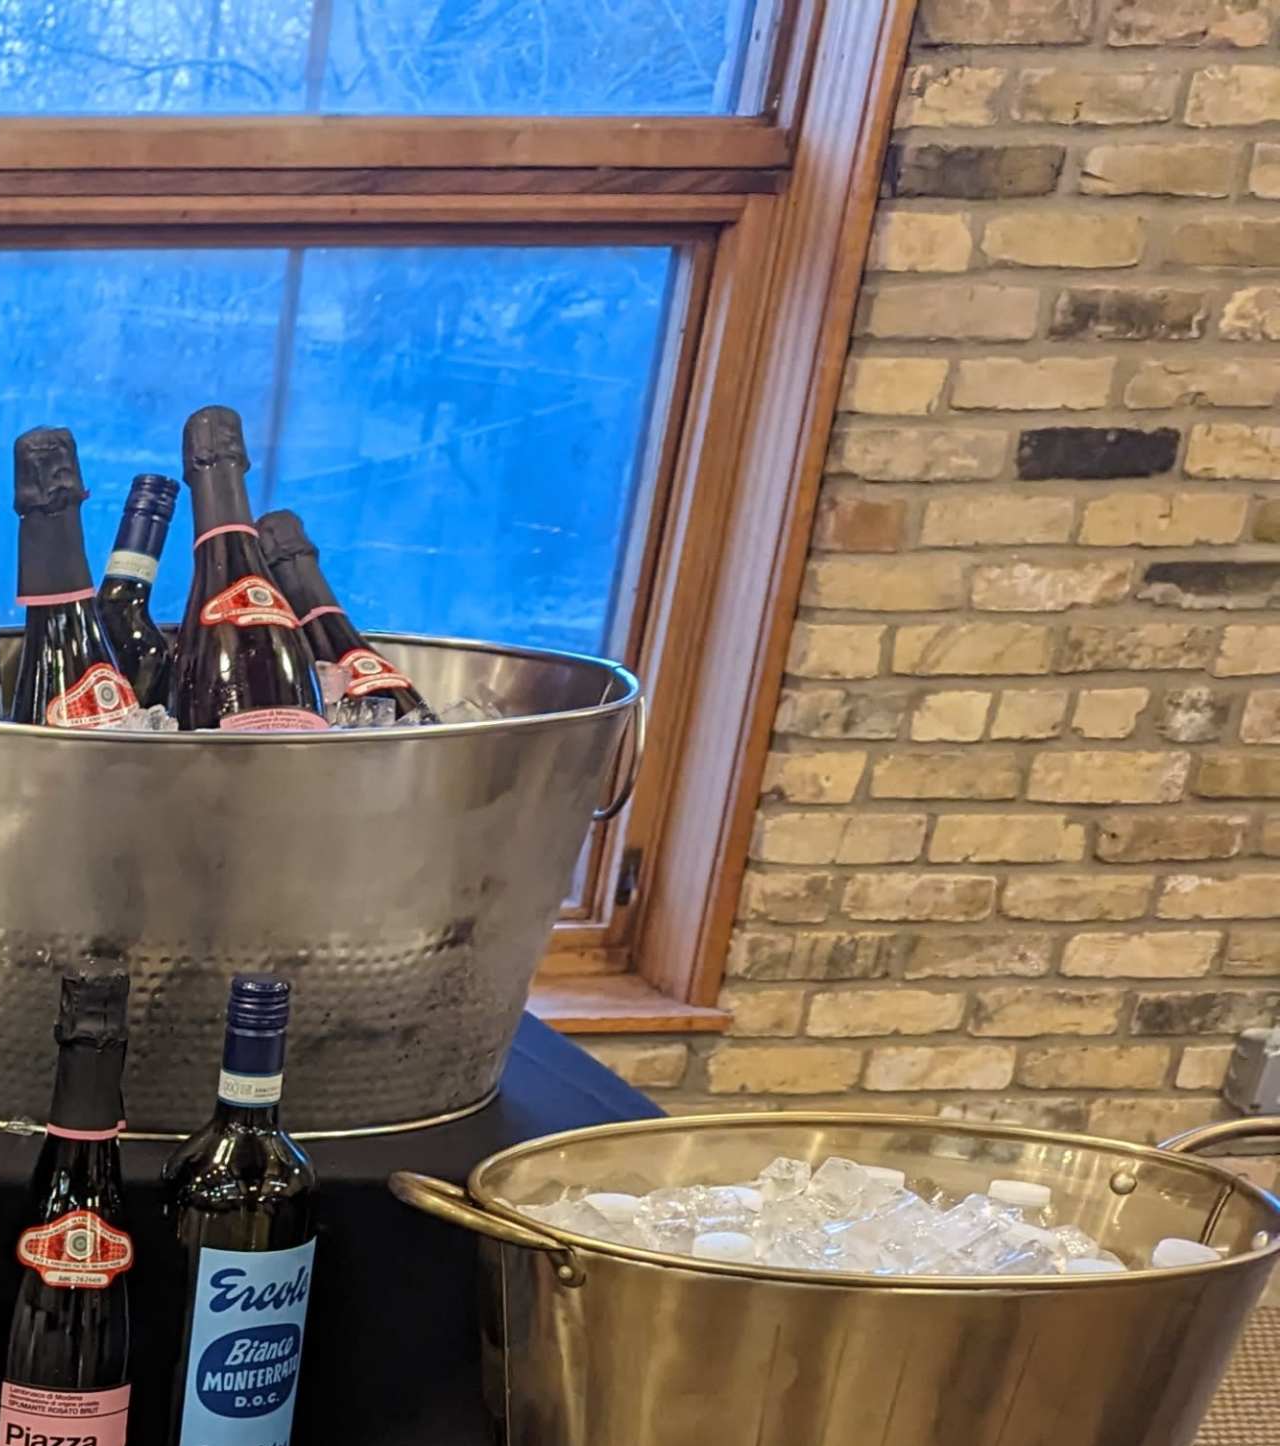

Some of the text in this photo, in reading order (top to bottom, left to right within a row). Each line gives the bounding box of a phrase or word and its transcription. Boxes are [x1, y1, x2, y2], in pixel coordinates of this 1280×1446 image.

[209, 1265, 310, 1313] Ercole
[224, 1335, 294, 1366] Bianco
[234, 1393, 280, 1408] D.O.C.
